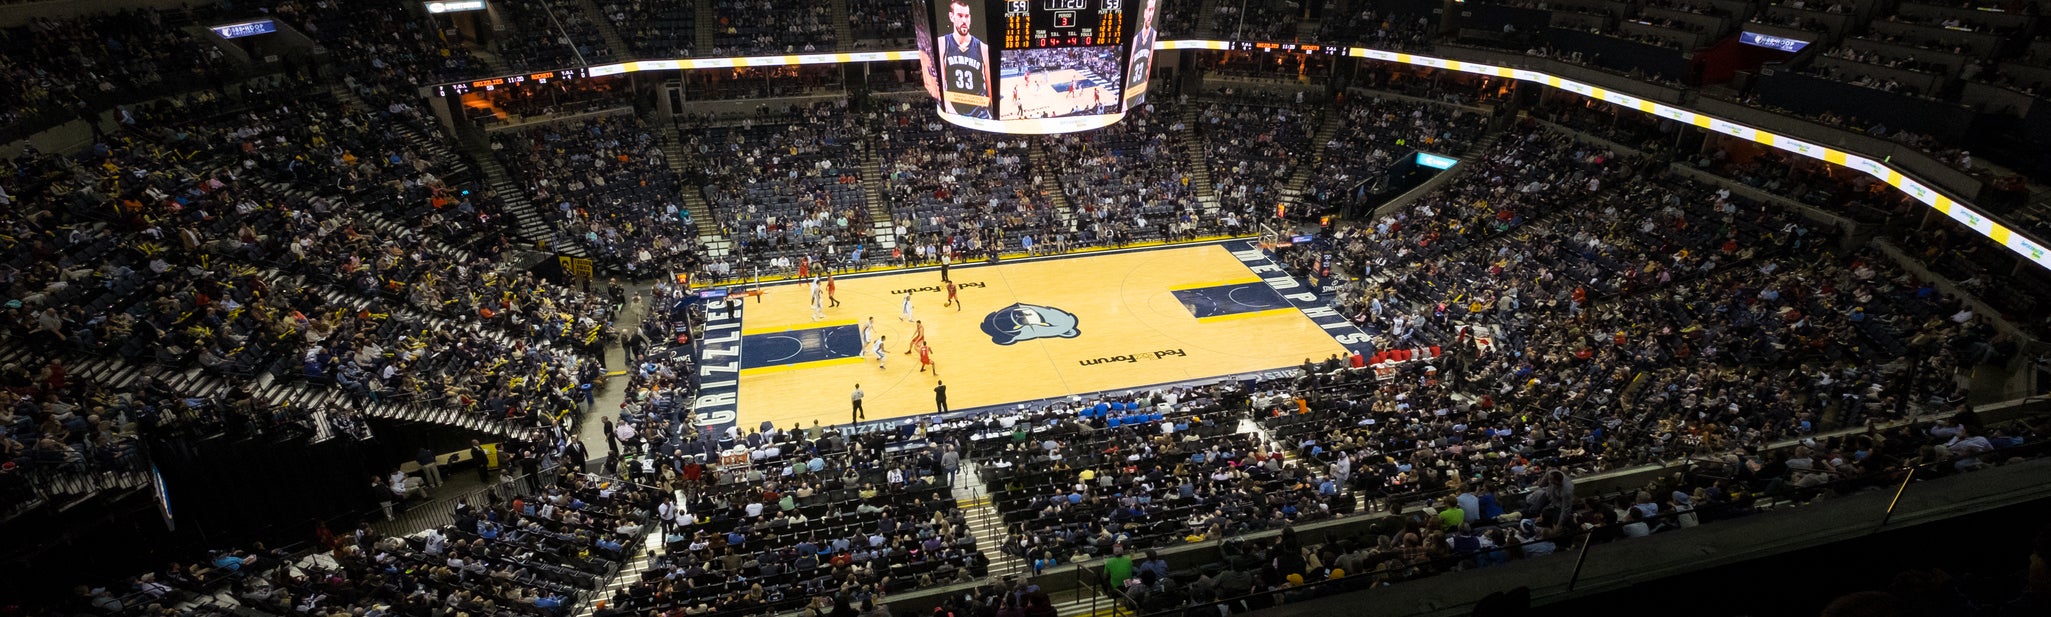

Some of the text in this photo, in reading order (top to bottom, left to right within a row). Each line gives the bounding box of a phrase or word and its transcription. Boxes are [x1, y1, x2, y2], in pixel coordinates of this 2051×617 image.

[1012, 1, 1026, 11] 59
[1061, 17, 1068, 26] 3
[947, 55, 981, 70] MEMPHIS
[955, 69, 974, 90] 33
[1132, 62, 1144, 82] 33
[694, 298, 743, 427] GRIZZLIES
